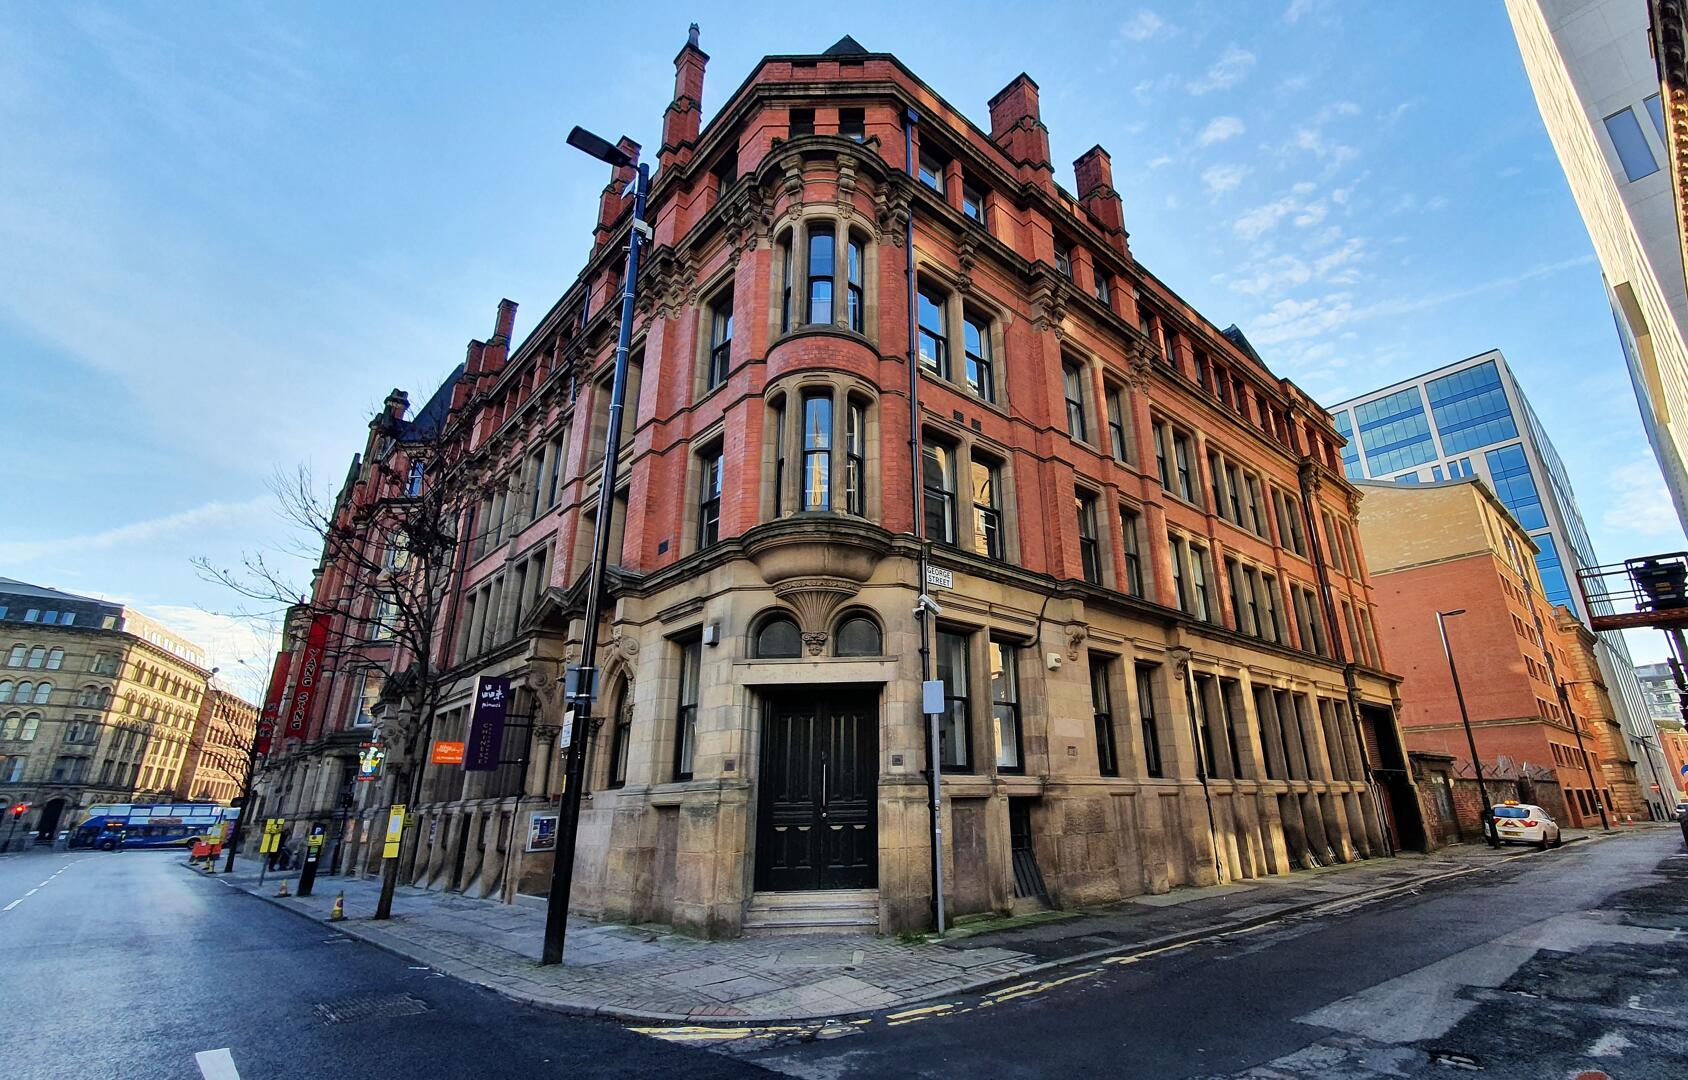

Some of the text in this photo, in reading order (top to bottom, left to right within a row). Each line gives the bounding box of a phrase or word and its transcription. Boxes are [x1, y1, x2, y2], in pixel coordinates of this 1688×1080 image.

[927, 566, 950, 579] GEORGE
[928, 575, 950, 586] STREET
[292, 648, 320, 730] YANG SING
[478, 723, 488, 763] CHINESE
[314, 827, 322, 835] P
